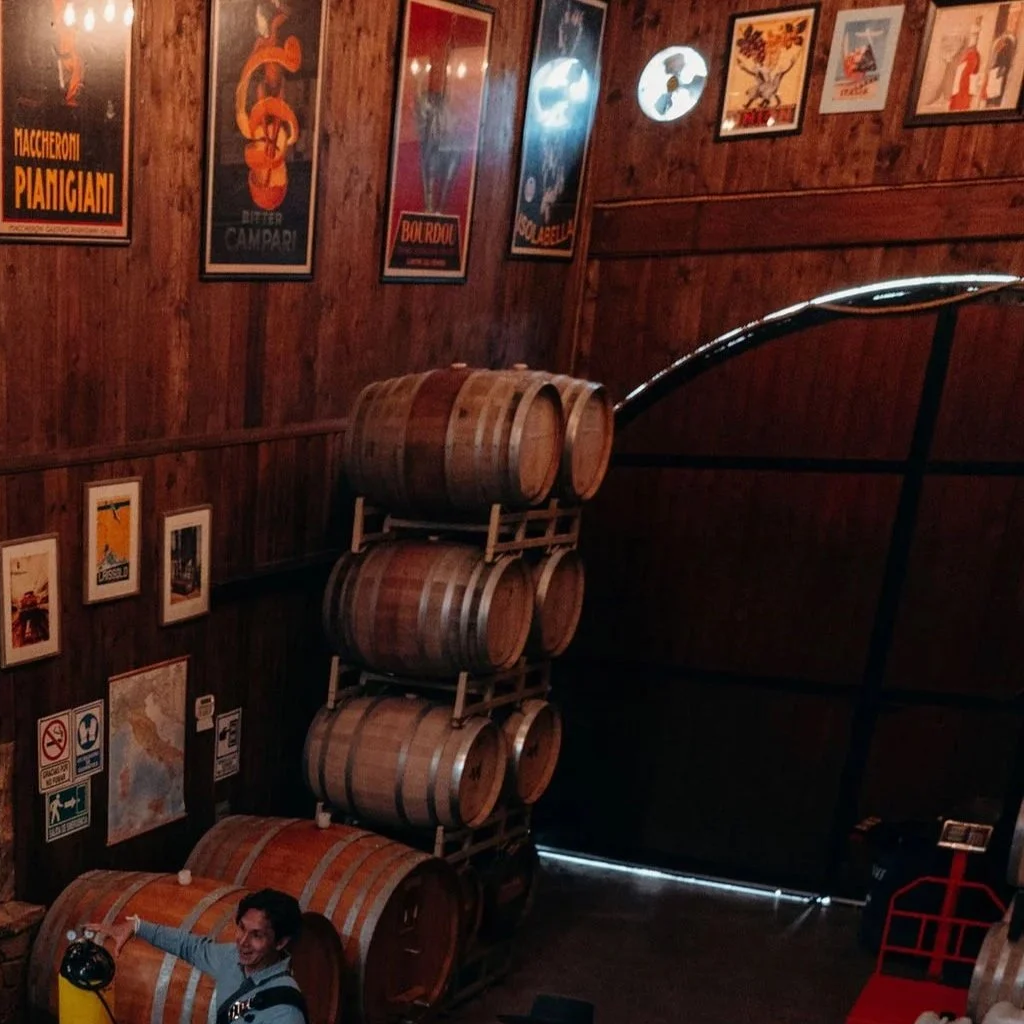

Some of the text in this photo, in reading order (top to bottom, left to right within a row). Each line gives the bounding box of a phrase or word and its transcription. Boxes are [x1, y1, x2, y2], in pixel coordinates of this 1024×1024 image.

[14, 127, 80, 161] MACCHERONI
[15, 165, 114, 215] PIANIGIANI
[242, 209, 283, 226] BITTER
[225, 227, 297, 252] CAMPARI
